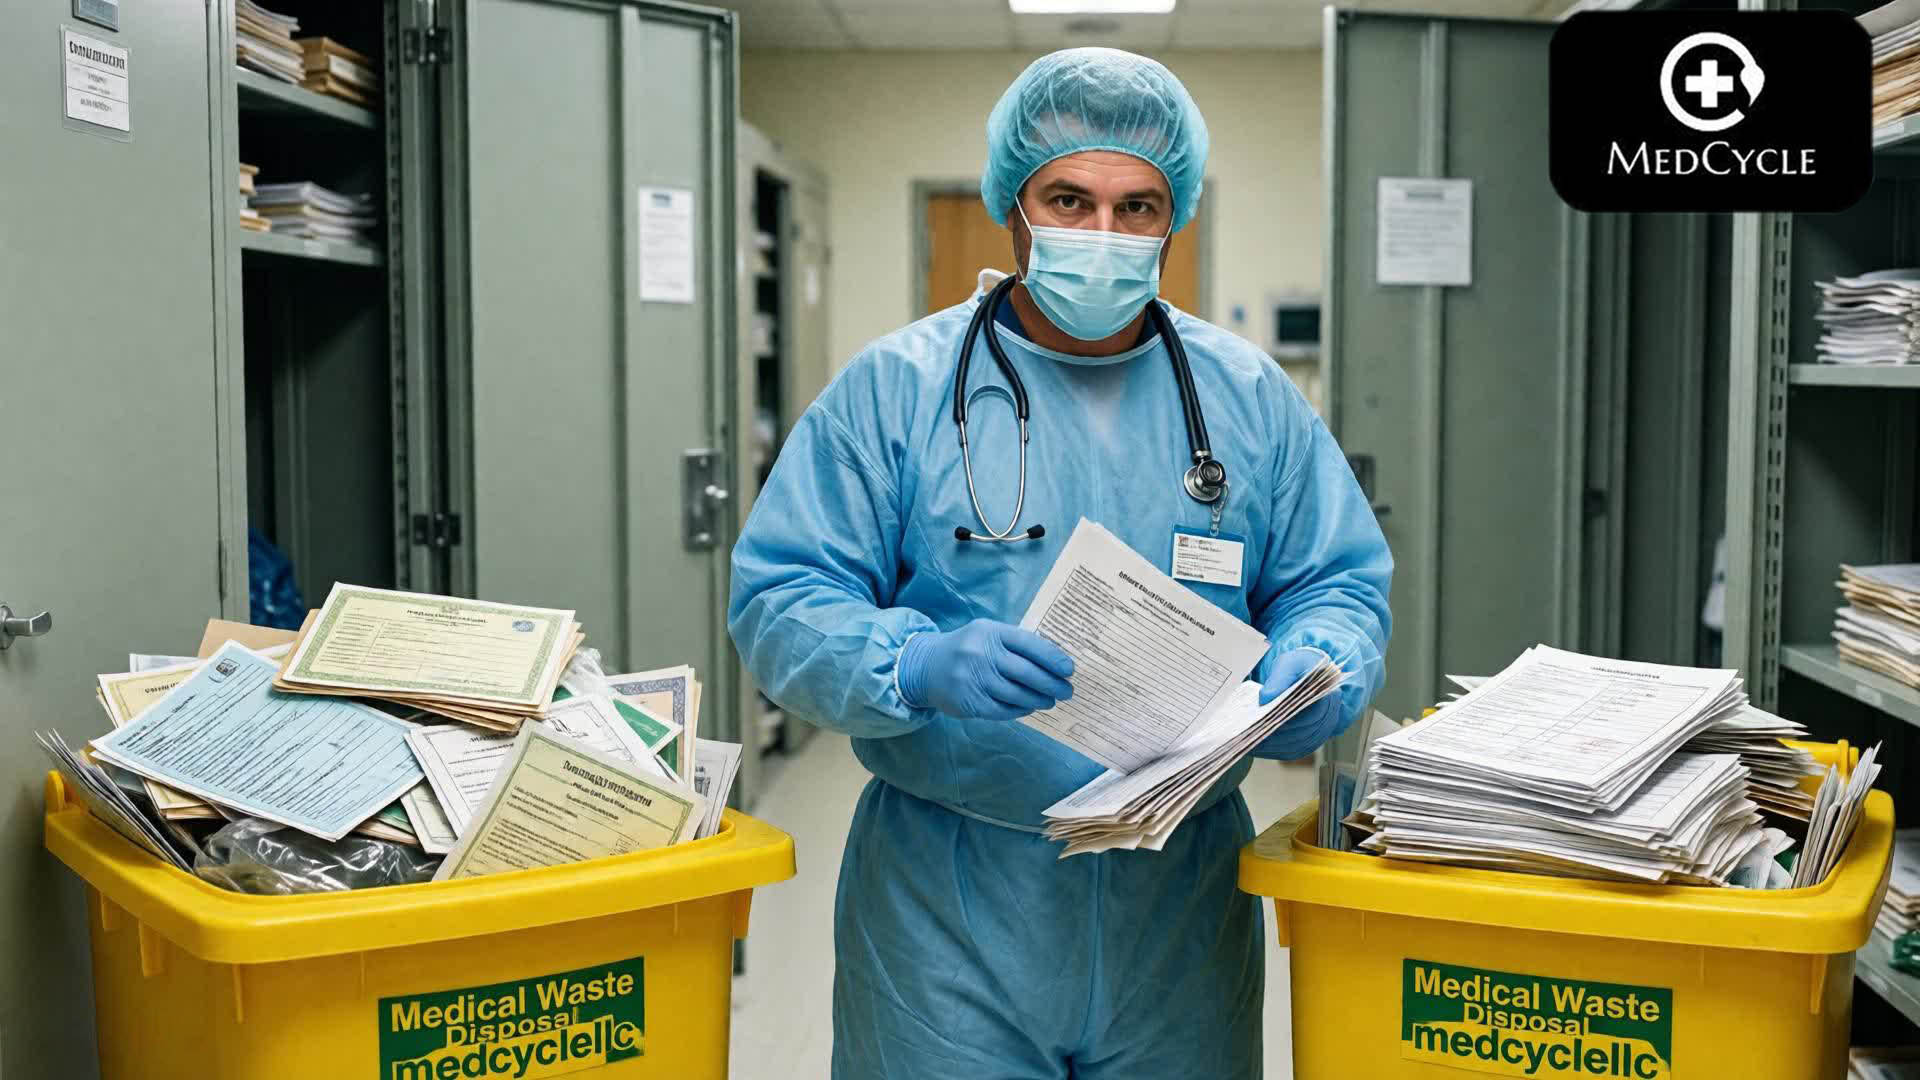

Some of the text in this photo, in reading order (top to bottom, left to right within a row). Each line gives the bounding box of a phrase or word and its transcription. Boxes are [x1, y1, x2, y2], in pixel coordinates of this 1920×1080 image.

[391, 971, 634, 1032] Medical Waste
[1414, 967, 1660, 1022] Medical Waste
[1464, 1002, 1589, 1036] Disposal
[395, 1015, 636, 1080] medcyclellc
[446, 1007, 579, 1048] Disposal
[1413, 1023, 1658, 1079] medcyclellc
